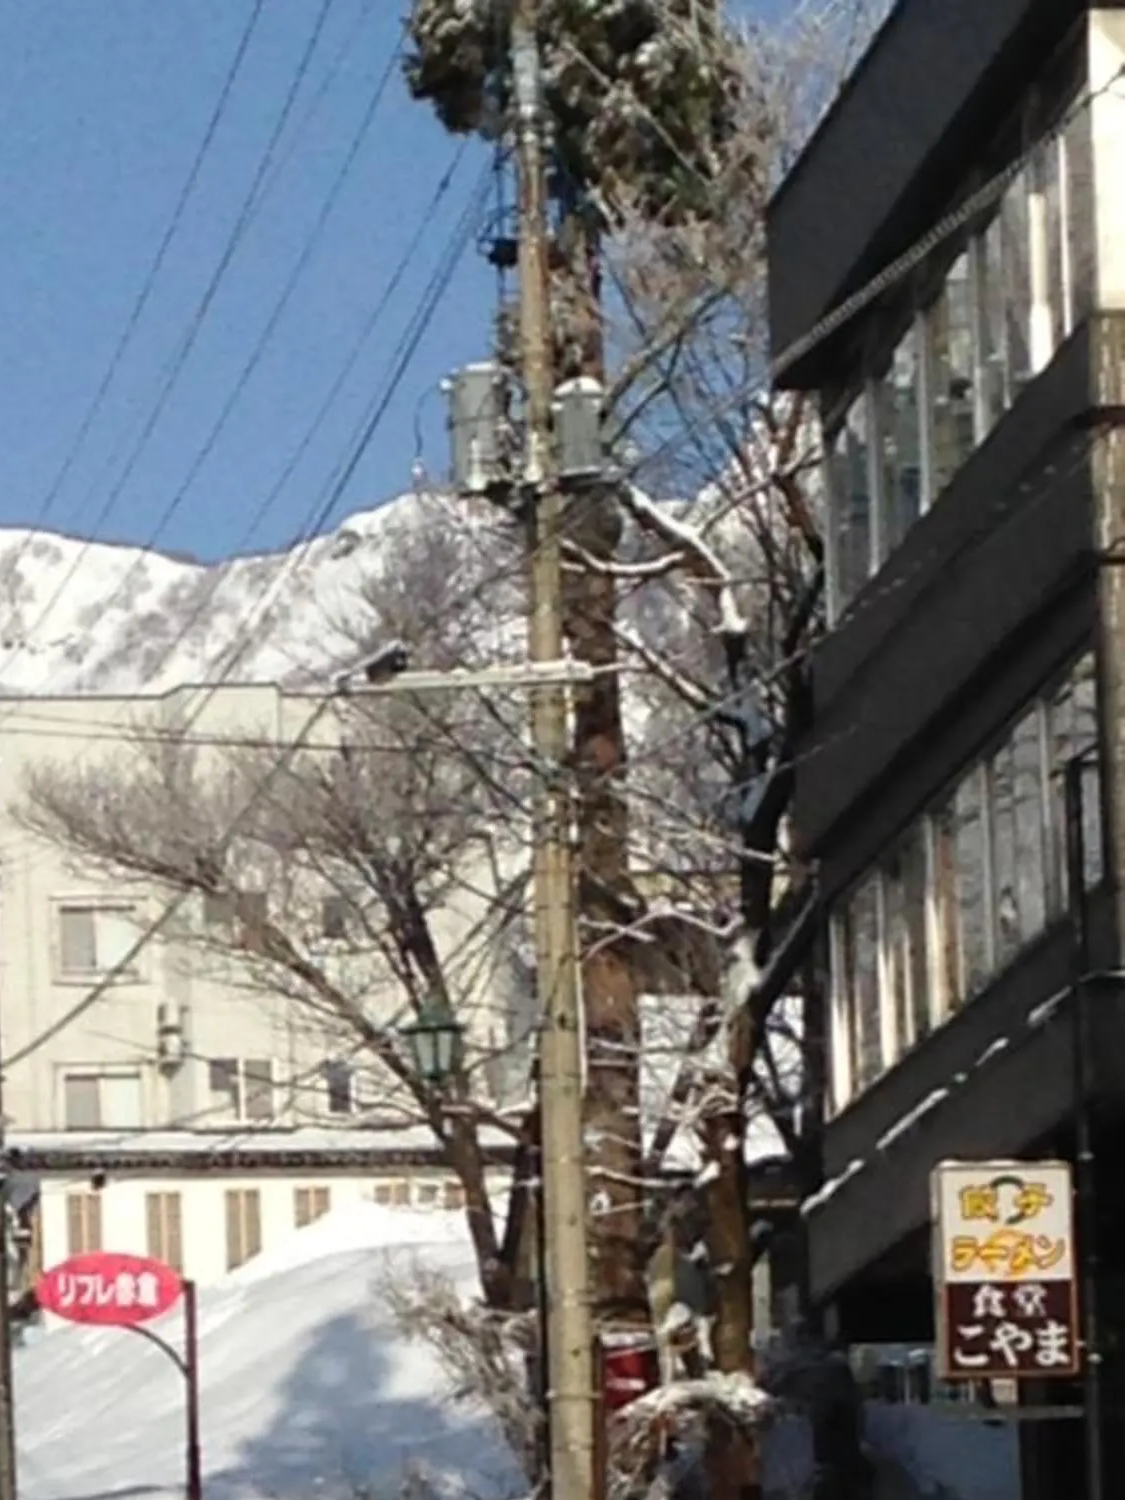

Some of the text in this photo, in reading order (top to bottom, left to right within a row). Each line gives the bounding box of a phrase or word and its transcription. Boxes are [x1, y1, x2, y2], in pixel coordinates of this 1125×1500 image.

[951, 1235, 1065, 1272] ラーメン
[953, 1321, 1070, 1366] こやま
